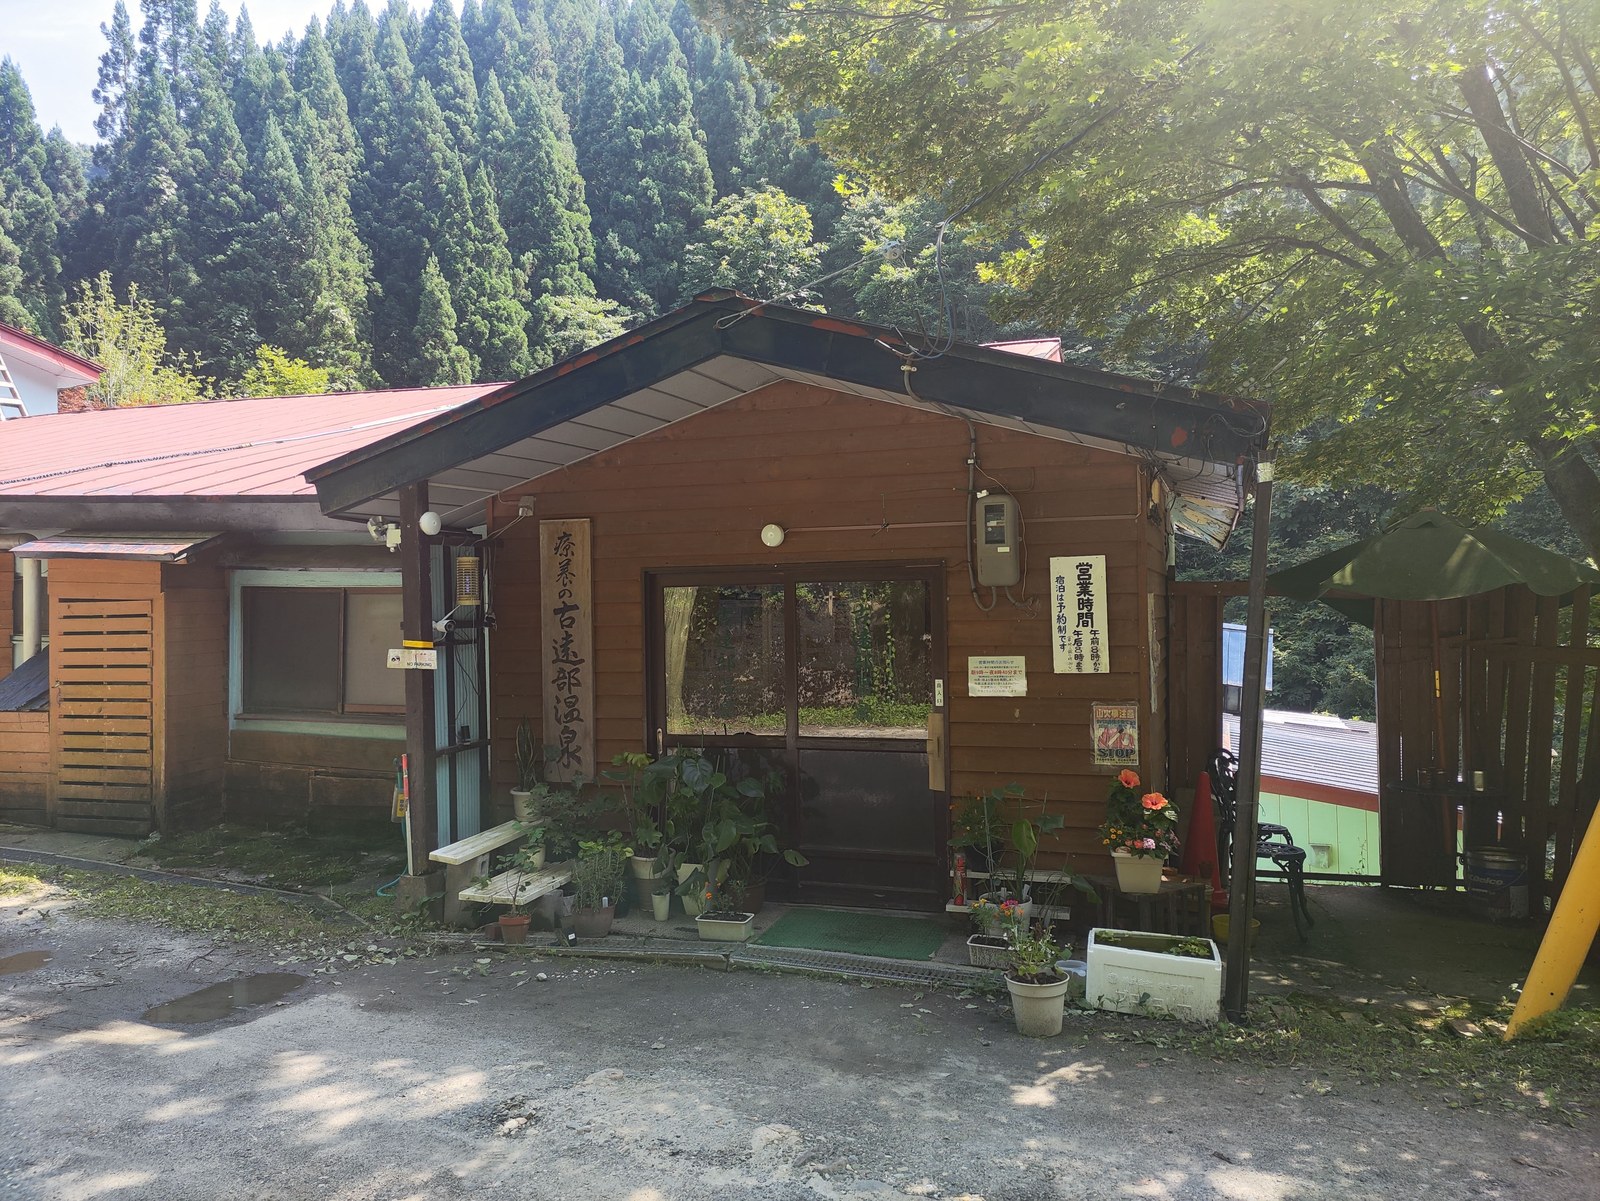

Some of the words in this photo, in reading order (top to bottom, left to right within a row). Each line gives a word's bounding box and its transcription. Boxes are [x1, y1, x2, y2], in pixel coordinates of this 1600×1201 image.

[1055, 575, 1067, 652] 宿泊は予約制です
[1075, 562, 1095, 629] 営業時間
[1097, 748, 1136, 758] STOP
